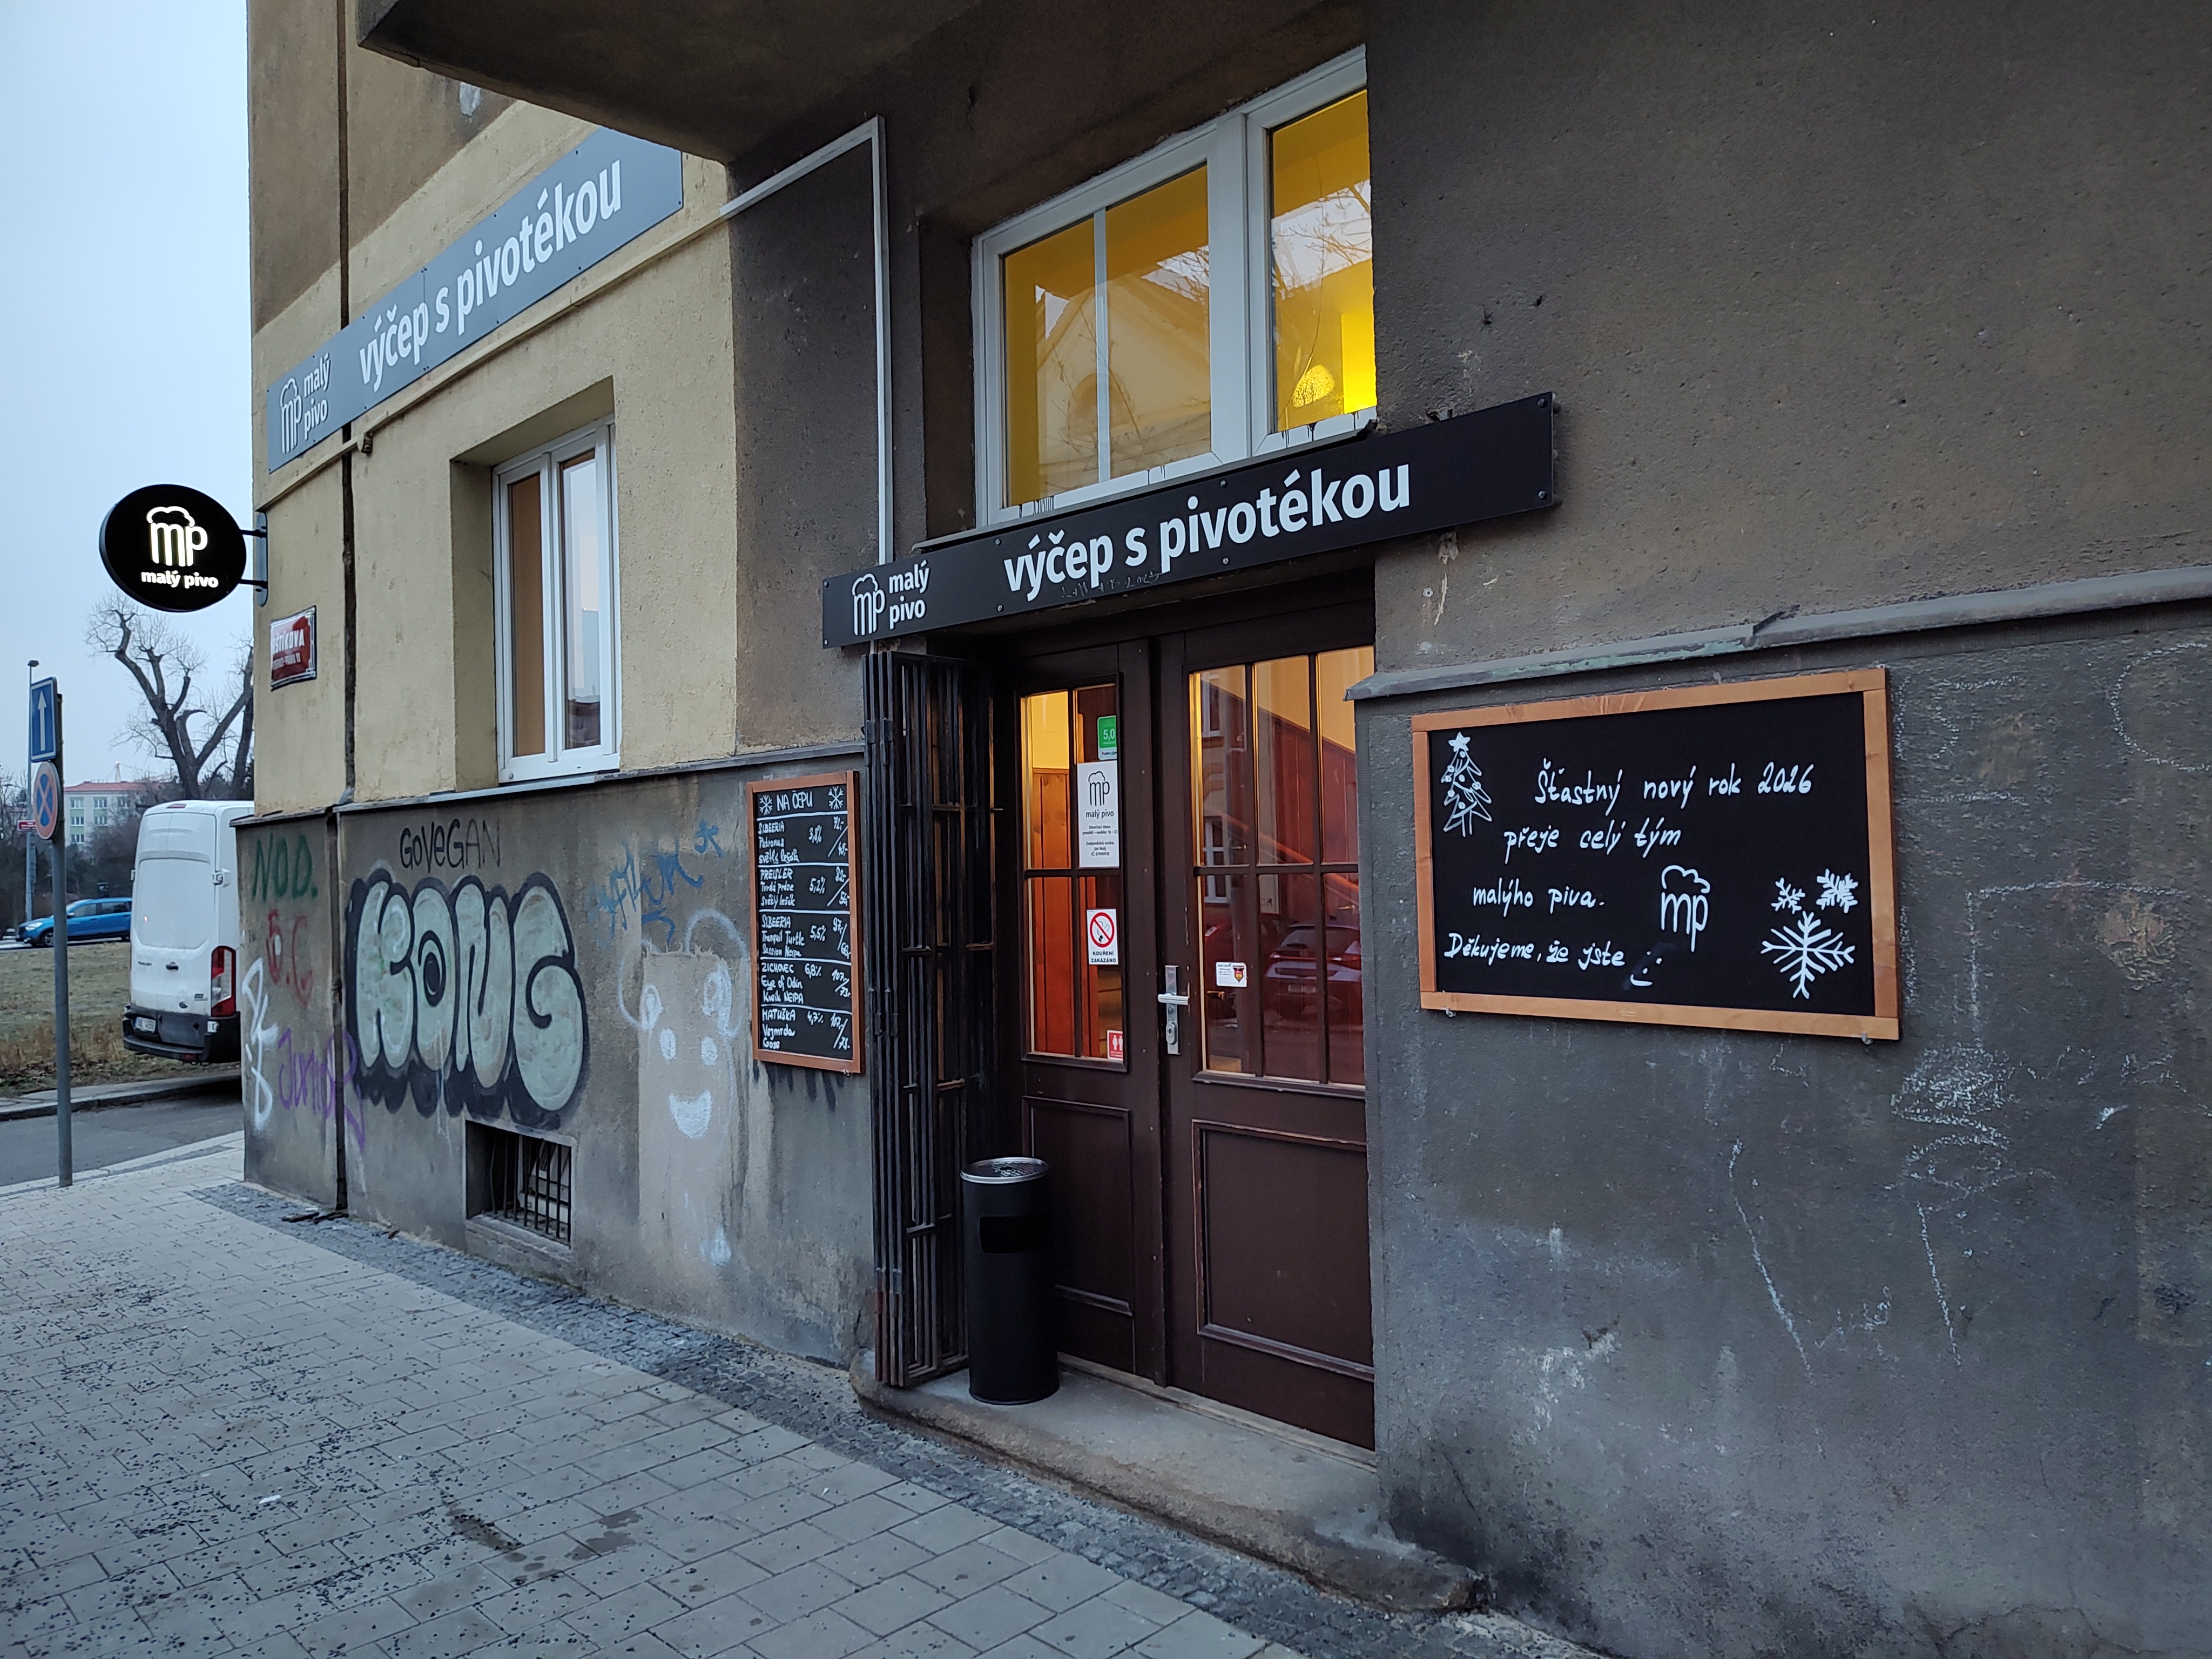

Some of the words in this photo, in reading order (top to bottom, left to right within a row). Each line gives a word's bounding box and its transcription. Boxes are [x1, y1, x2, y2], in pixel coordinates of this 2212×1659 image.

[359, 305, 428, 392] výčep
[436, 287, 449, 333] s
[457, 160, 622, 336] pivotékou
[304, 352, 331, 398] malý
[304, 397, 329, 441] pivo
[1003, 529, 1114, 602] výčep
[1125, 527, 1148, 567] s
[1159, 464, 1411, 575] pivotékou
[140, 570, 181, 588] malý
[184, 571, 219, 589] pivo
[889, 559, 930, 594] malý
[889, 595, 926, 630] pivo
[1103, 728, 1115, 741] 5,0
[1534, 758, 1623, 815] Šťastný
[1643, 765, 1697, 810] nový
[1708, 762, 1741, 795] rok
[1756, 761, 1814, 795] 2026
[776, 793, 791, 811] NA
[792, 790, 813, 808] ČEPU
[1085, 809, 1100, 820] malý
[1101, 809, 1115, 820] pivo
[758, 820, 785, 835] SIBEERIA
[758, 836, 785, 849] Patronus
[1503, 825, 1559, 864] přeje
[1579, 819, 1626, 855] celý
[1634, 817, 1681, 858] tým
[760, 867, 793, 881] PREISLER
[1473, 877, 1534, 917] malýho
[1548, 882, 1606, 914] piva.
[761, 914, 791, 929] SIBEERIA
[761, 929, 783, 945] Tranquil
[785, 930, 805, 947] Turtle
[762, 943, 783, 956] Session
[1546, 939, 1569, 964] že
[1578, 941, 1625, 970] jste
[761, 962, 794, 974] ZICHOVEC
[760, 975, 777, 991] Eye
[778, 974, 785, 992] of
[786, 976, 804, 989] Odin
[763, 989, 781, 1002] Kveik
[762, 1008, 796, 1022] MATUŠKA
[763, 1037, 780, 1049] Gose
